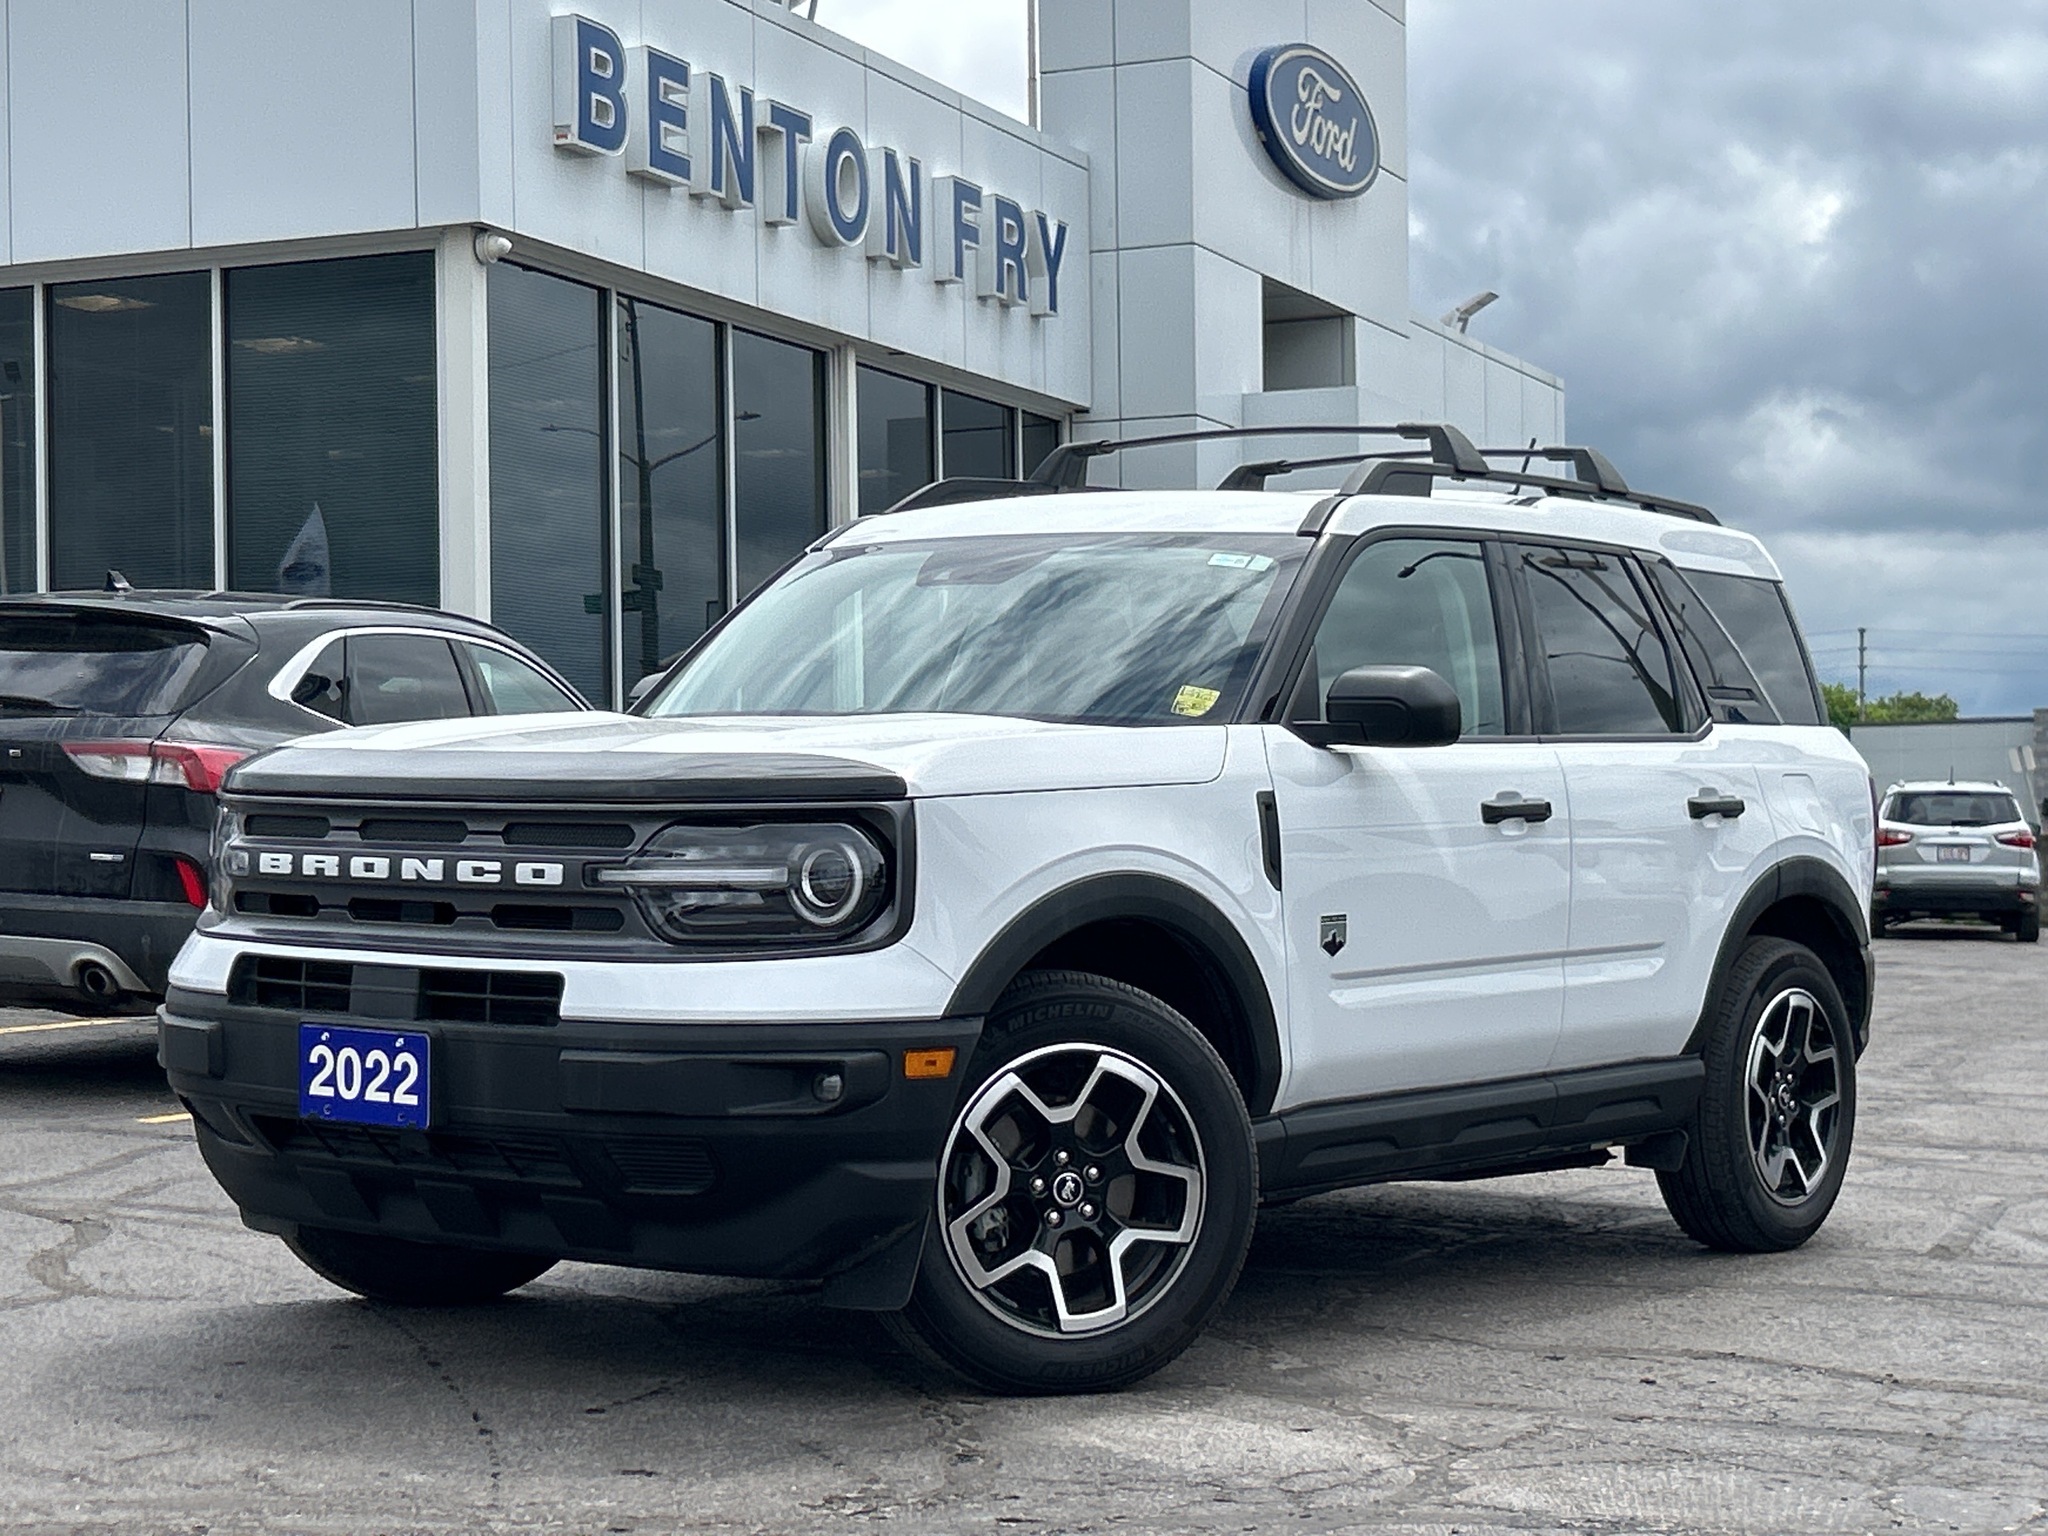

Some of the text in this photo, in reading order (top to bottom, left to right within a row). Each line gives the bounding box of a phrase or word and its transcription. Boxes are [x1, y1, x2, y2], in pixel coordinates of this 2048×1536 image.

[1291, 66, 1358, 173] Ford
[571, 14, 1068, 316] BENTON FRY
[258, 852, 565, 886] BRONCO
[1008, 1003, 1111, 1032] MICHELIN
[308, 1044, 419, 1106] 2022
